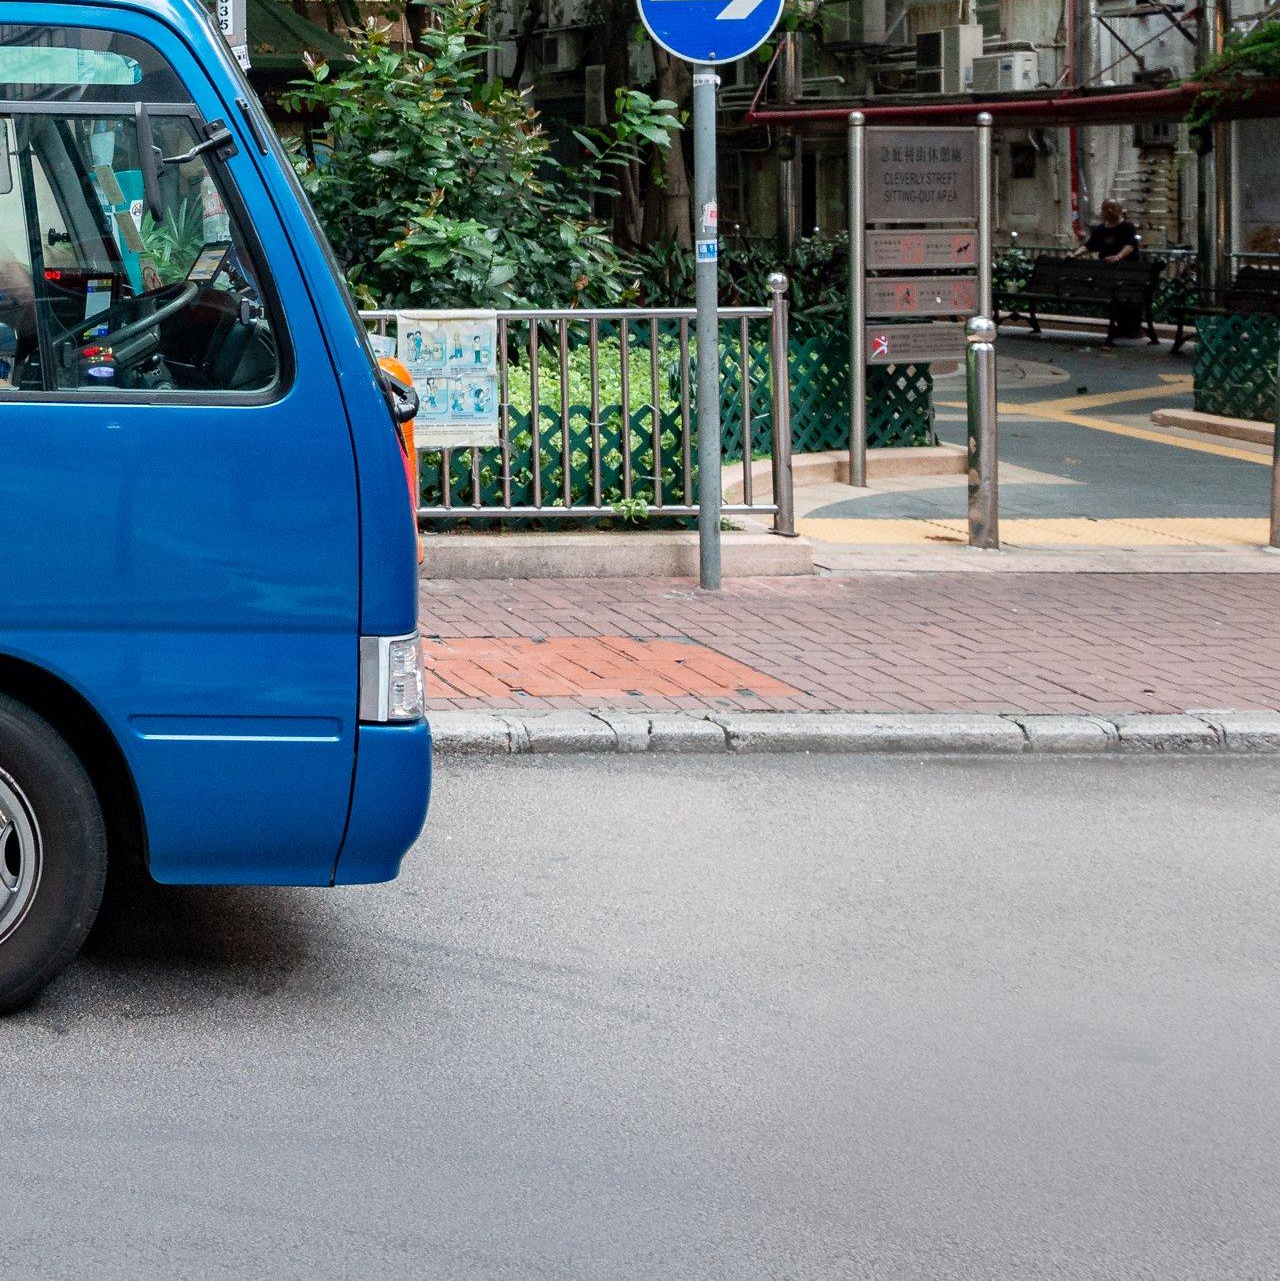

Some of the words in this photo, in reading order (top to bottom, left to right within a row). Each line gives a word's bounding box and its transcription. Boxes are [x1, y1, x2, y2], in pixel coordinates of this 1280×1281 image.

[883, 171, 925, 186] CLEVERLY
[926, 172, 957, 186] STREET
[883, 189, 936, 204] SITTING-OUT
[937, 189, 958, 204] AREA
